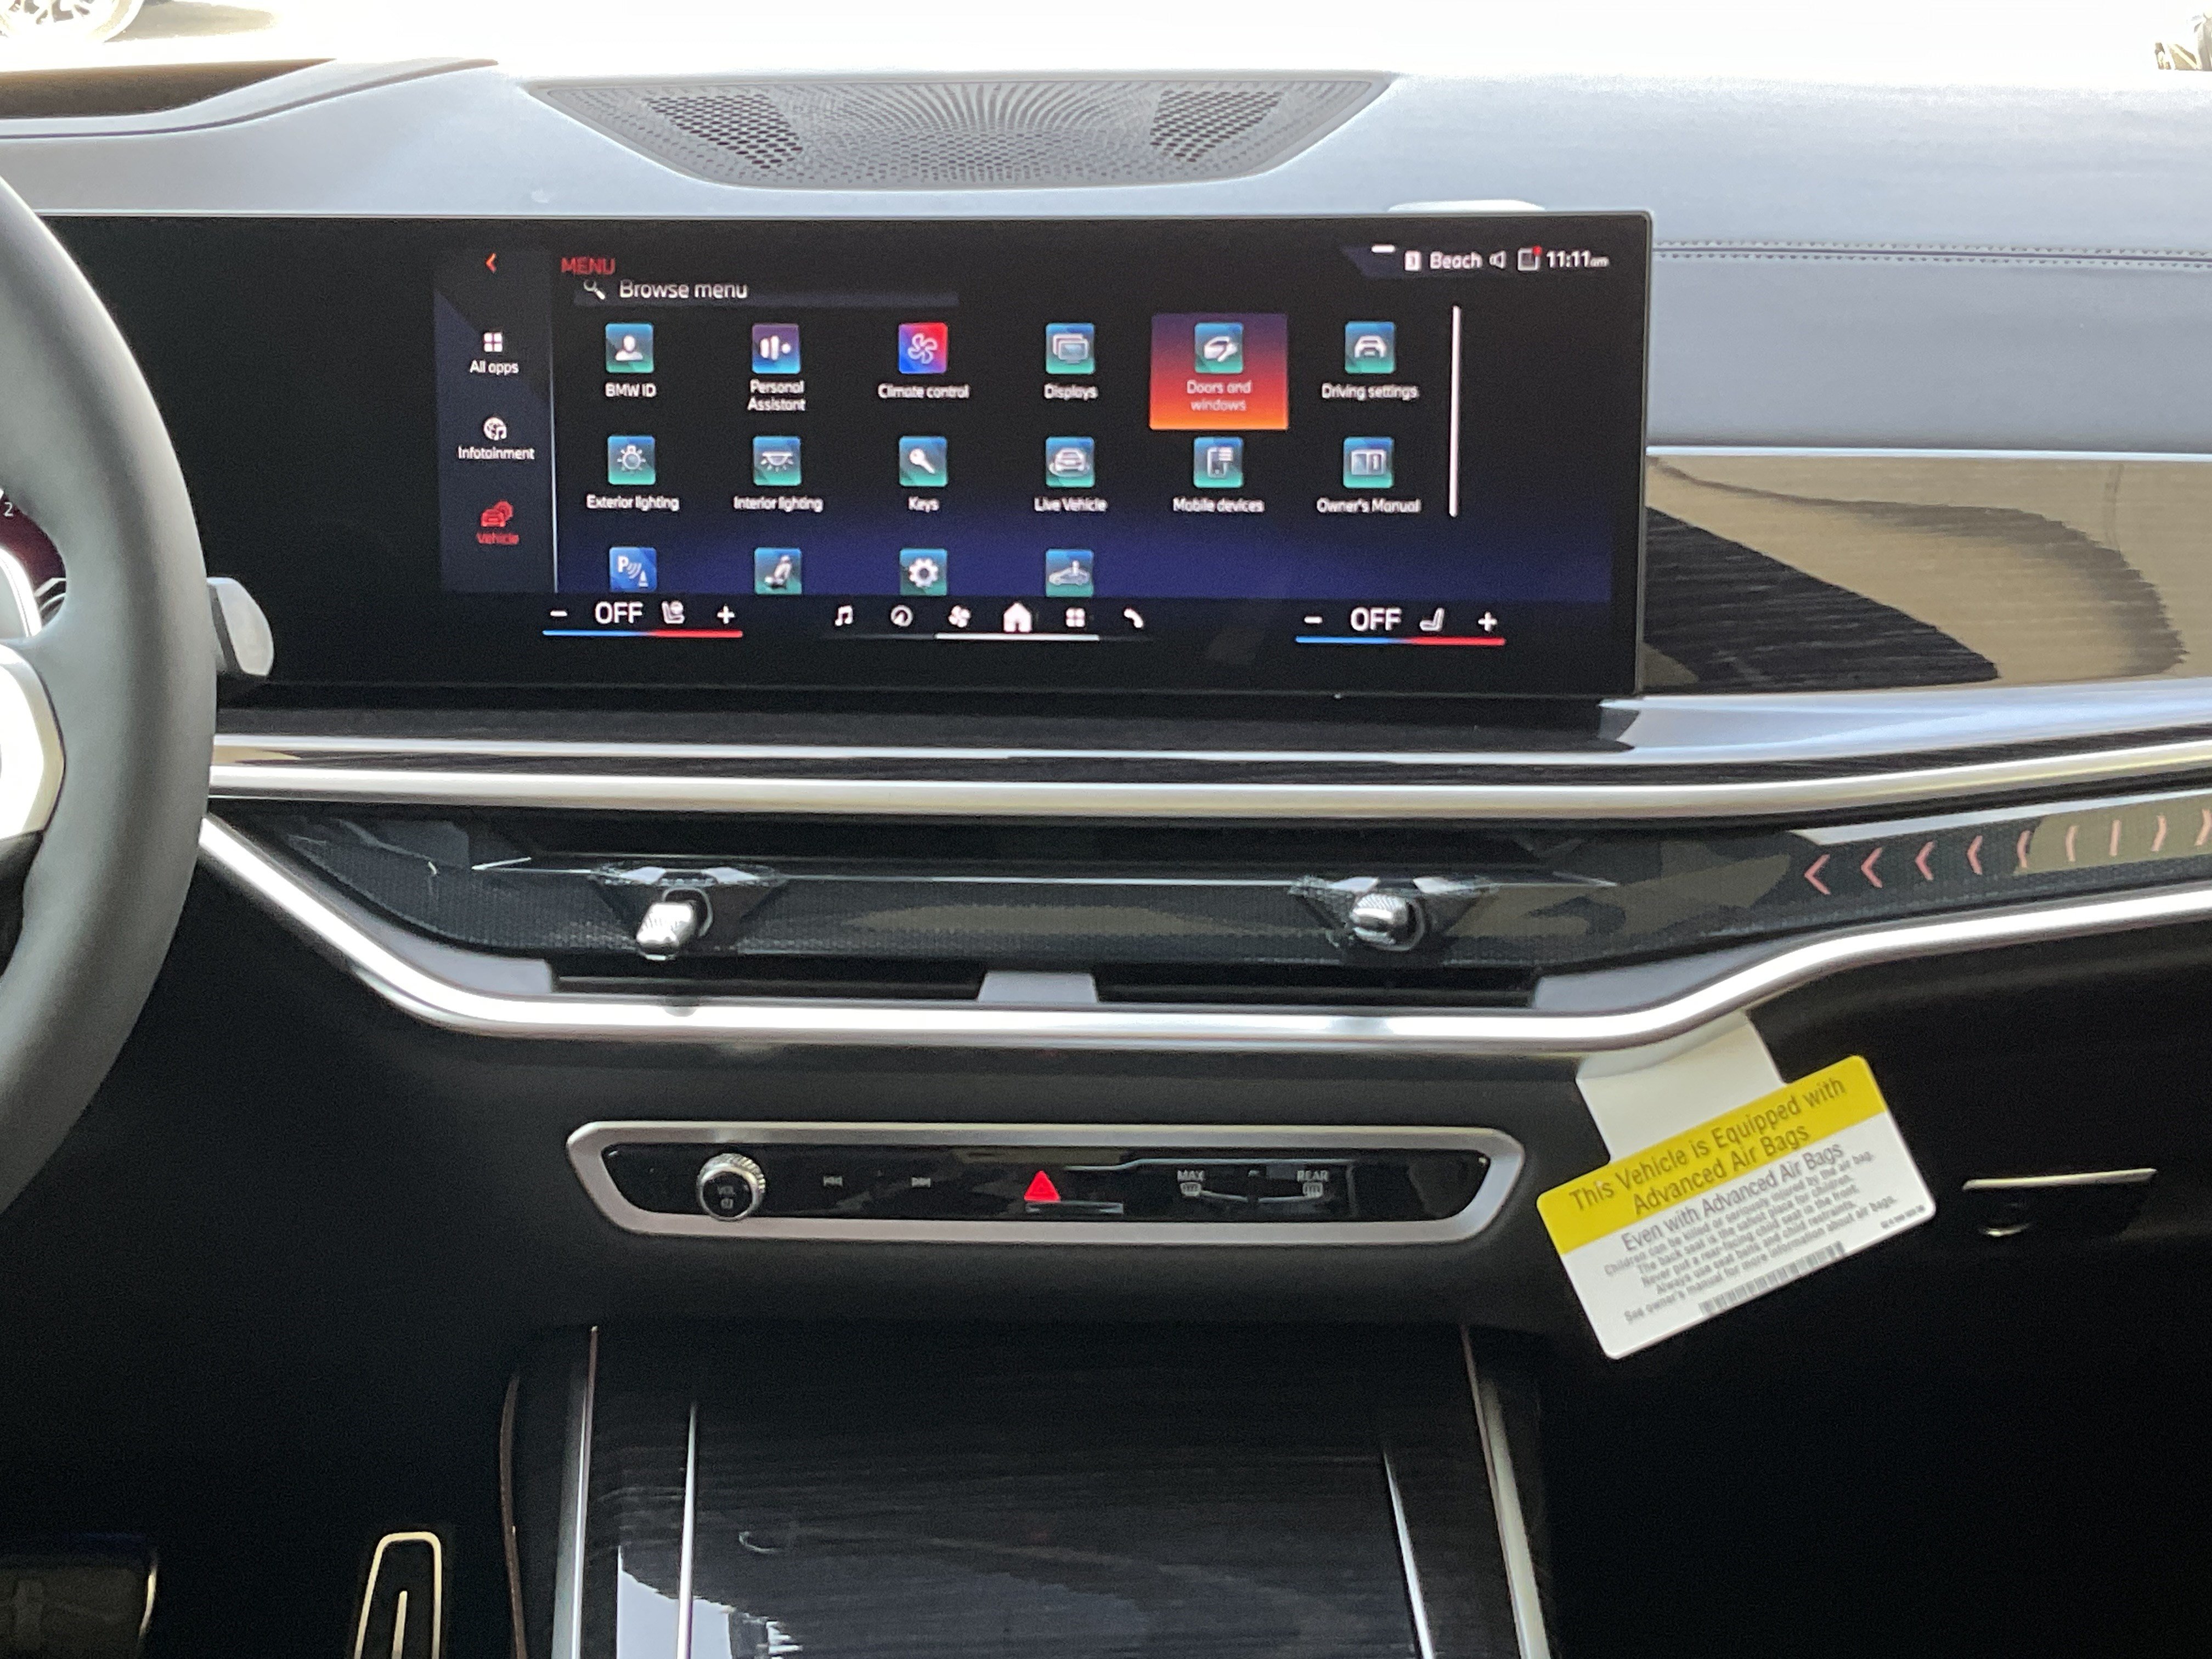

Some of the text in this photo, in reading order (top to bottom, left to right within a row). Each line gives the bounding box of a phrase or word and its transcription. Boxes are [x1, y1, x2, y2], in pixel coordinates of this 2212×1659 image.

[561, 257, 615, 274] MENU
[1430, 252, 1482, 269] Beach
[620, 280, 747, 298] Browse menu
[470, 360, 518, 375] All apps
[606, 383, 656, 397] BMW ID
[751, 379, 804, 393] Personal
[878, 384, 969, 398] Climate control
[1045, 383, 1098, 400] Displays
[1187, 380, 1251, 393] Doors and
[1322, 383, 1419, 400] Driving settings
[748, 395, 805, 410] Assistant
[1191, 399, 1246, 411] windows
[459, 446, 534, 459] Infotainment
[587, 494, 680, 511] Exterior lighting
[734, 496, 823, 512] Interior lighting
[909, 496, 939, 512] Keys
[1035, 498, 1107, 511] Live Vehicle
[1173, 498, 1264, 512] Mobile devices
[1317, 498, 1420, 512] Owner's Manual
[595, 602, 643, 624] OFF
[1351, 607, 1401, 631] OFF
[1569, 1078, 1846, 1211] This Vehicle is Equipped with
[1634, 1126, 1810, 1215] Advanced Air Bags
[1621, 1144, 1844, 1251] Even with Advanced Air Bags
